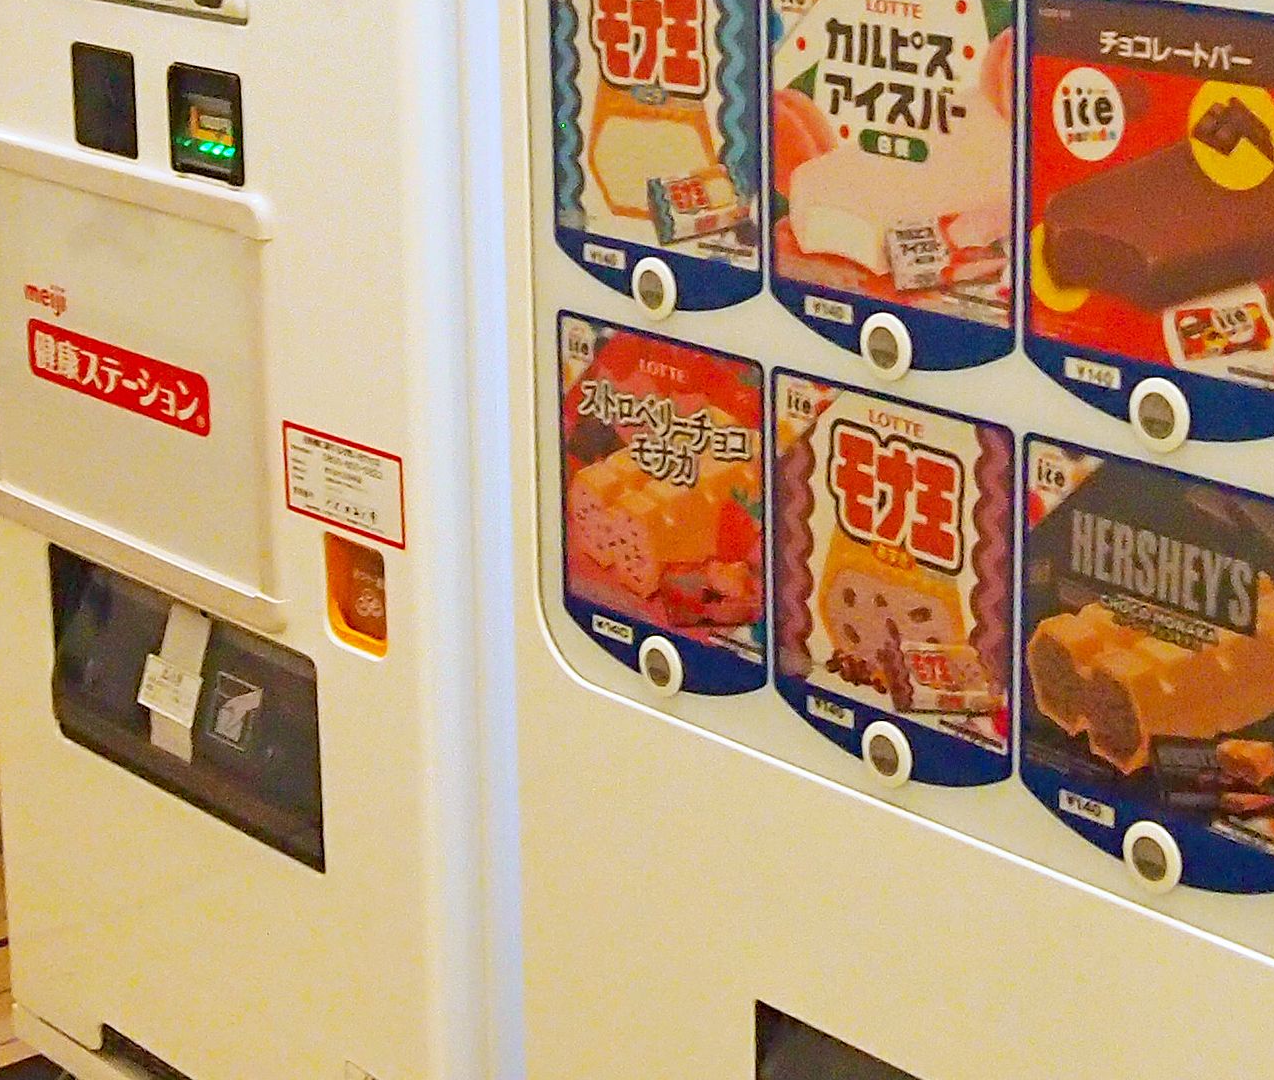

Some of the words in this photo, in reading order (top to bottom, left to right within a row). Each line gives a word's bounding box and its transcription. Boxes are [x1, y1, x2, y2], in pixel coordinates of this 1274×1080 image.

[825, 17, 954, 81] カルピス
[1099, 30, 1253, 71] チョコレートバー
[824, 72, 966, 134] アイスバー
[1061, 86, 1114, 128] ice
[33, 331, 199, 422] 健康ステーション
[638, 357, 687, 385] LOTTE
[579, 379, 752, 461] ストロベリーチョコ
[869, 409, 924, 438] LOTTE
[632, 432, 699, 488] モナカ
[837, 429, 957, 561] モナ王
[1070, 508, 1253, 628] HERSHEY'S
